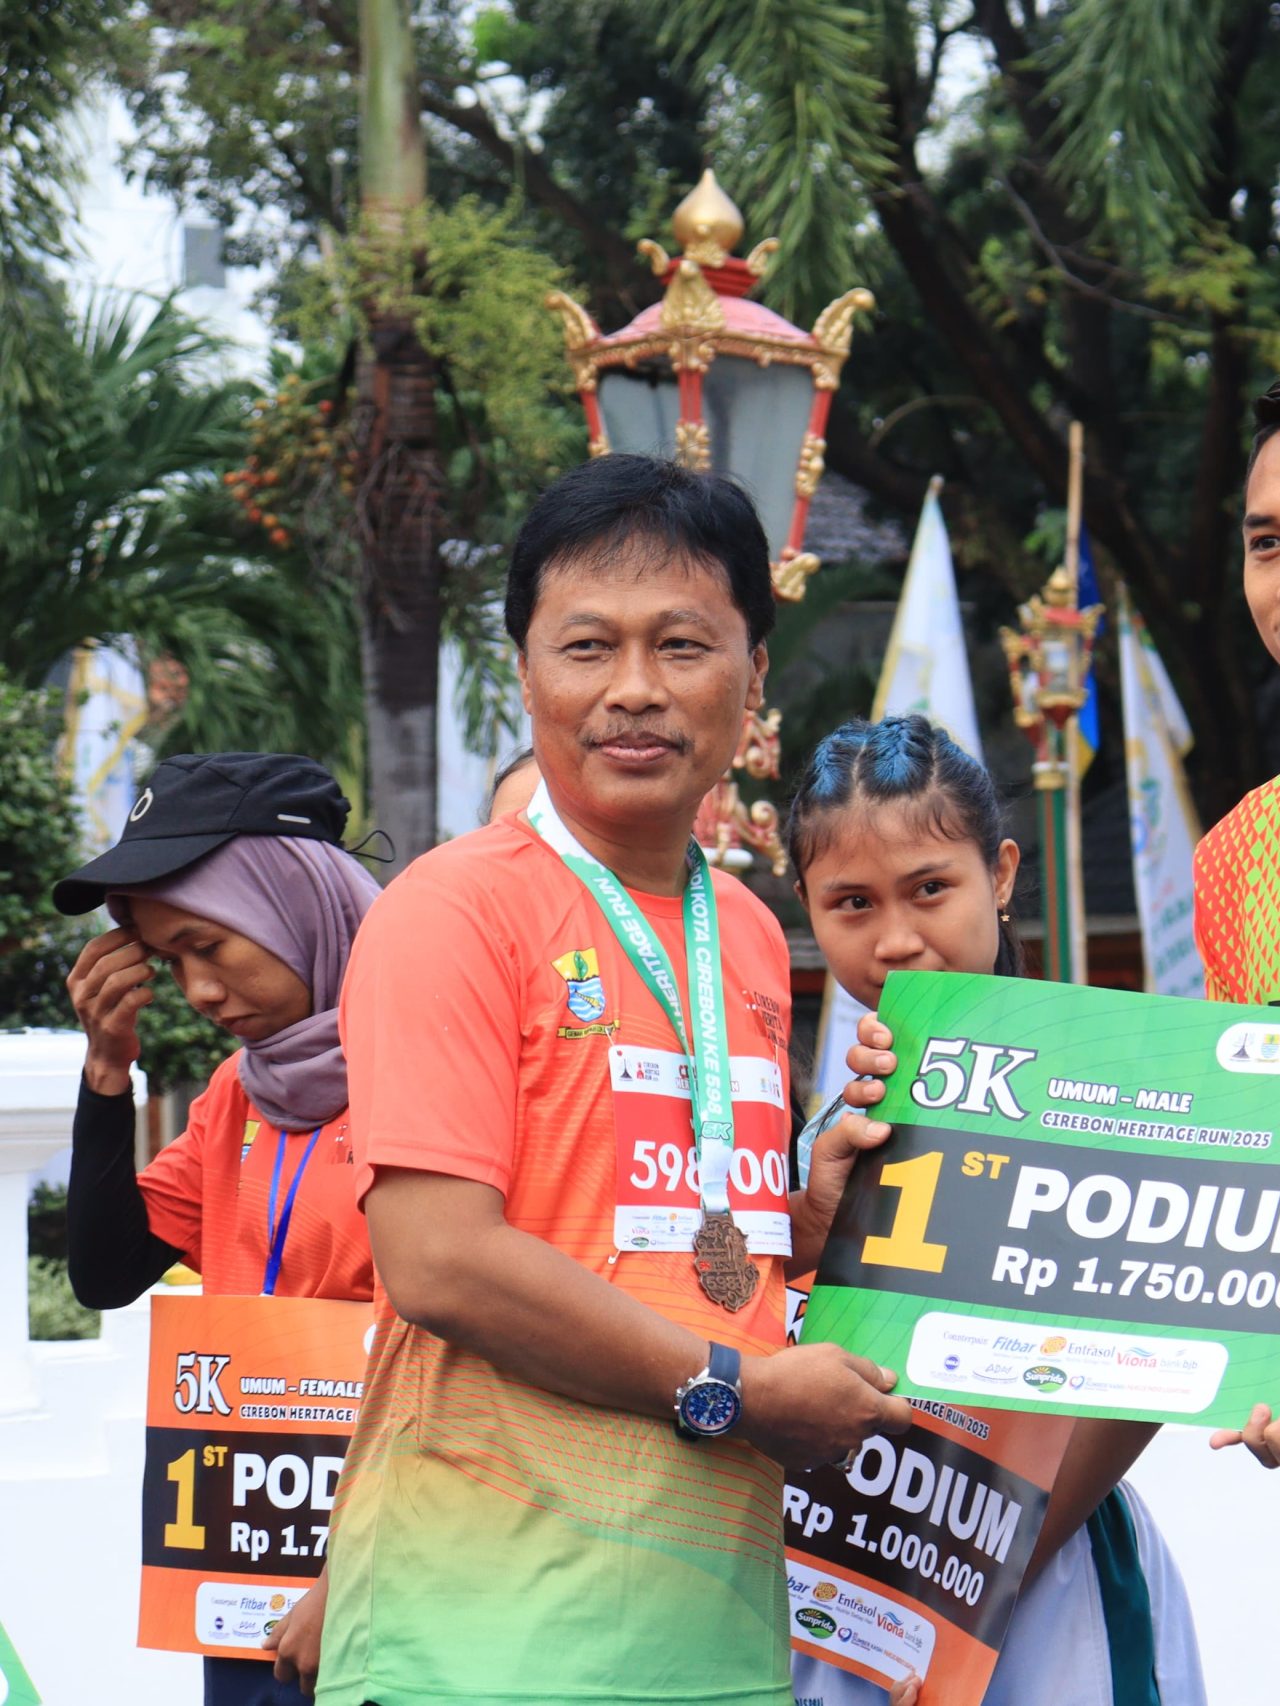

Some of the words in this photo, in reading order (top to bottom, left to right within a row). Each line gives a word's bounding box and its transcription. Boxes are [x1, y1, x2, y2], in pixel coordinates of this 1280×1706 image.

[593, 877, 632, 916] RUN
[690, 893, 711, 942] KOTA
[620, 918, 683, 1018] HERITAGE
[695, 947, 718, 1044] CIREBON
[702, 1047, 720, 1072] KE
[911, 1037, 1038, 1121] 5K
[704, 1073, 724, 1115] 598
[1048, 1078, 1119, 1106] UMUM
[1135, 1089, 1193, 1113] MALE
[702, 1120, 732, 1140] 5K
[1042, 1112, 1114, 1135] CIREBON
[1117, 1121, 1196, 1143] HERITAGE
[1199, 1129, 1232, 1145] RUN
[1235, 1131, 1272, 1148] 2025
[860, 1151, 948, 1273] 1
[961, 1151, 1010, 1180] ST
[992, 1246, 1058, 1295] Rp
[992, 1336, 1038, 1354] Fitbar
[1068, 1342, 1116, 1359] Entrasol
[1116, 1352, 1157, 1368] Viona
[174, 1351, 233, 1416] 5K
[240, 1377, 286, 1395] UMUM
[299, 1379, 364, 1399] FEMALE
[1024, 1371, 1065, 1385] Sunpride
[240, 1405, 287, 1419] CIREBON
[289, 1407, 353, 1422] HERITAGE
[945, 1409, 966, 1428] RUN
[966, 1418, 990, 1440] 2025
[164, 1449, 205, 1549] 1
[203, 1445, 228, 1468] ST
[846, 1434, 1023, 1564] ODIUM
[230, 1521, 270, 1562] Rp
[783, 1484, 834, 1538] Rp
[846, 1513, 985, 1607] 1.000.000
[240, 1597, 267, 1610] Fitbar
[797, 1611, 834, 1631] Sunpride
[837, 1593, 877, 1618] Entrasol
[877, 1613, 905, 1638] Viona
